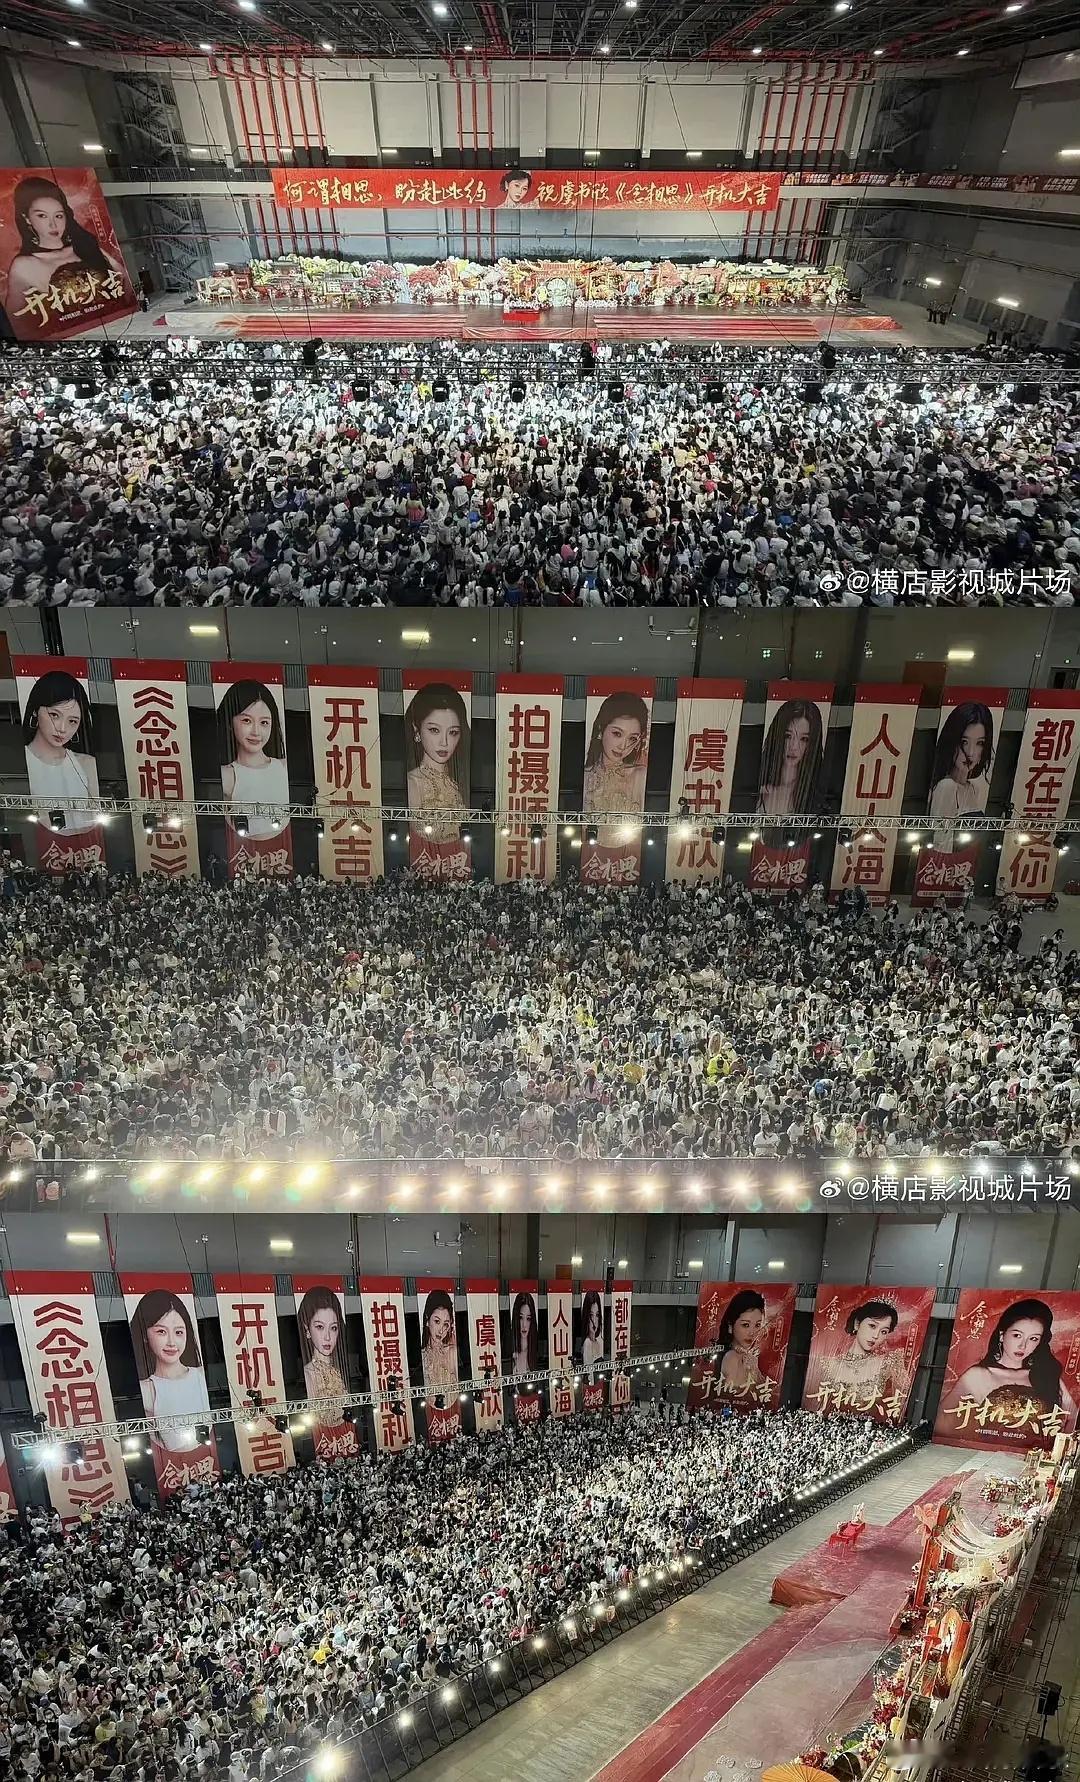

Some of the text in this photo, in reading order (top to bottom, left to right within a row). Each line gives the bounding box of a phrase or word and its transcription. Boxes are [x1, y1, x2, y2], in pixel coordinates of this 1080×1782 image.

[536, 180, 772, 207] 祝虞书欣《念相思》开机大吉
[13, 269, 125, 327] 开机大吉
[324, 698, 373, 875] 开机大吉
[507, 704, 551, 880] 拍摄顺利
[676, 728, 728, 868] 虞书欣
[842, 713, 900, 885] 人山人海
[41, 840, 106, 871] 念相思
[229, 845, 293, 875] 念相思
[411, 848, 471, 879] 念相思
[581, 852, 640, 881] 念相思
[751, 855, 808, 885] 念相思
[918, 857, 974, 887] 念相思
[692, 1371, 778, 1403] 开机大吉
[806, 1381, 908, 1418] 开机大吉
[944, 1394, 1071, 1437] 开机大吉
[159, 1456, 220, 1488] 念相思
